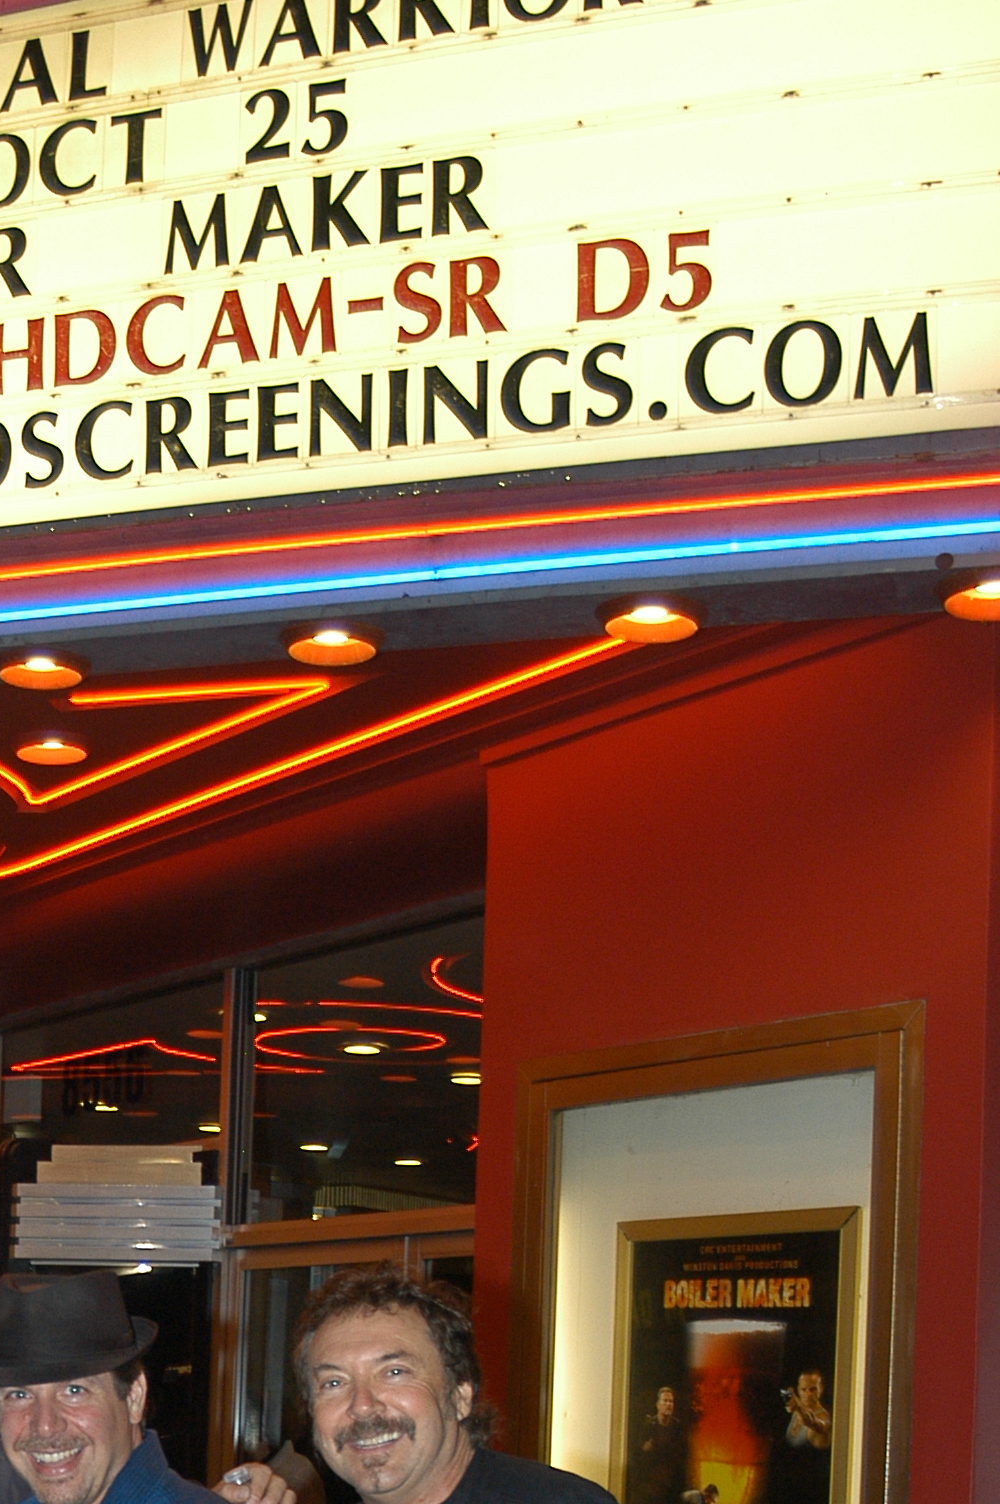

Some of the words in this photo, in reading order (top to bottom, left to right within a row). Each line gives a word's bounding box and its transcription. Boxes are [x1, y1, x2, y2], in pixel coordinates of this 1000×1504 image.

[188, 0, 643, 77] WARR
[244, 78, 349, 165] 25
[164, 155, 490, 275] MAKER
[576, 229, 713, 322] D5
[664, 1279, 732, 1309] BOILER
[737, 1278, 810, 1307] MAKER
